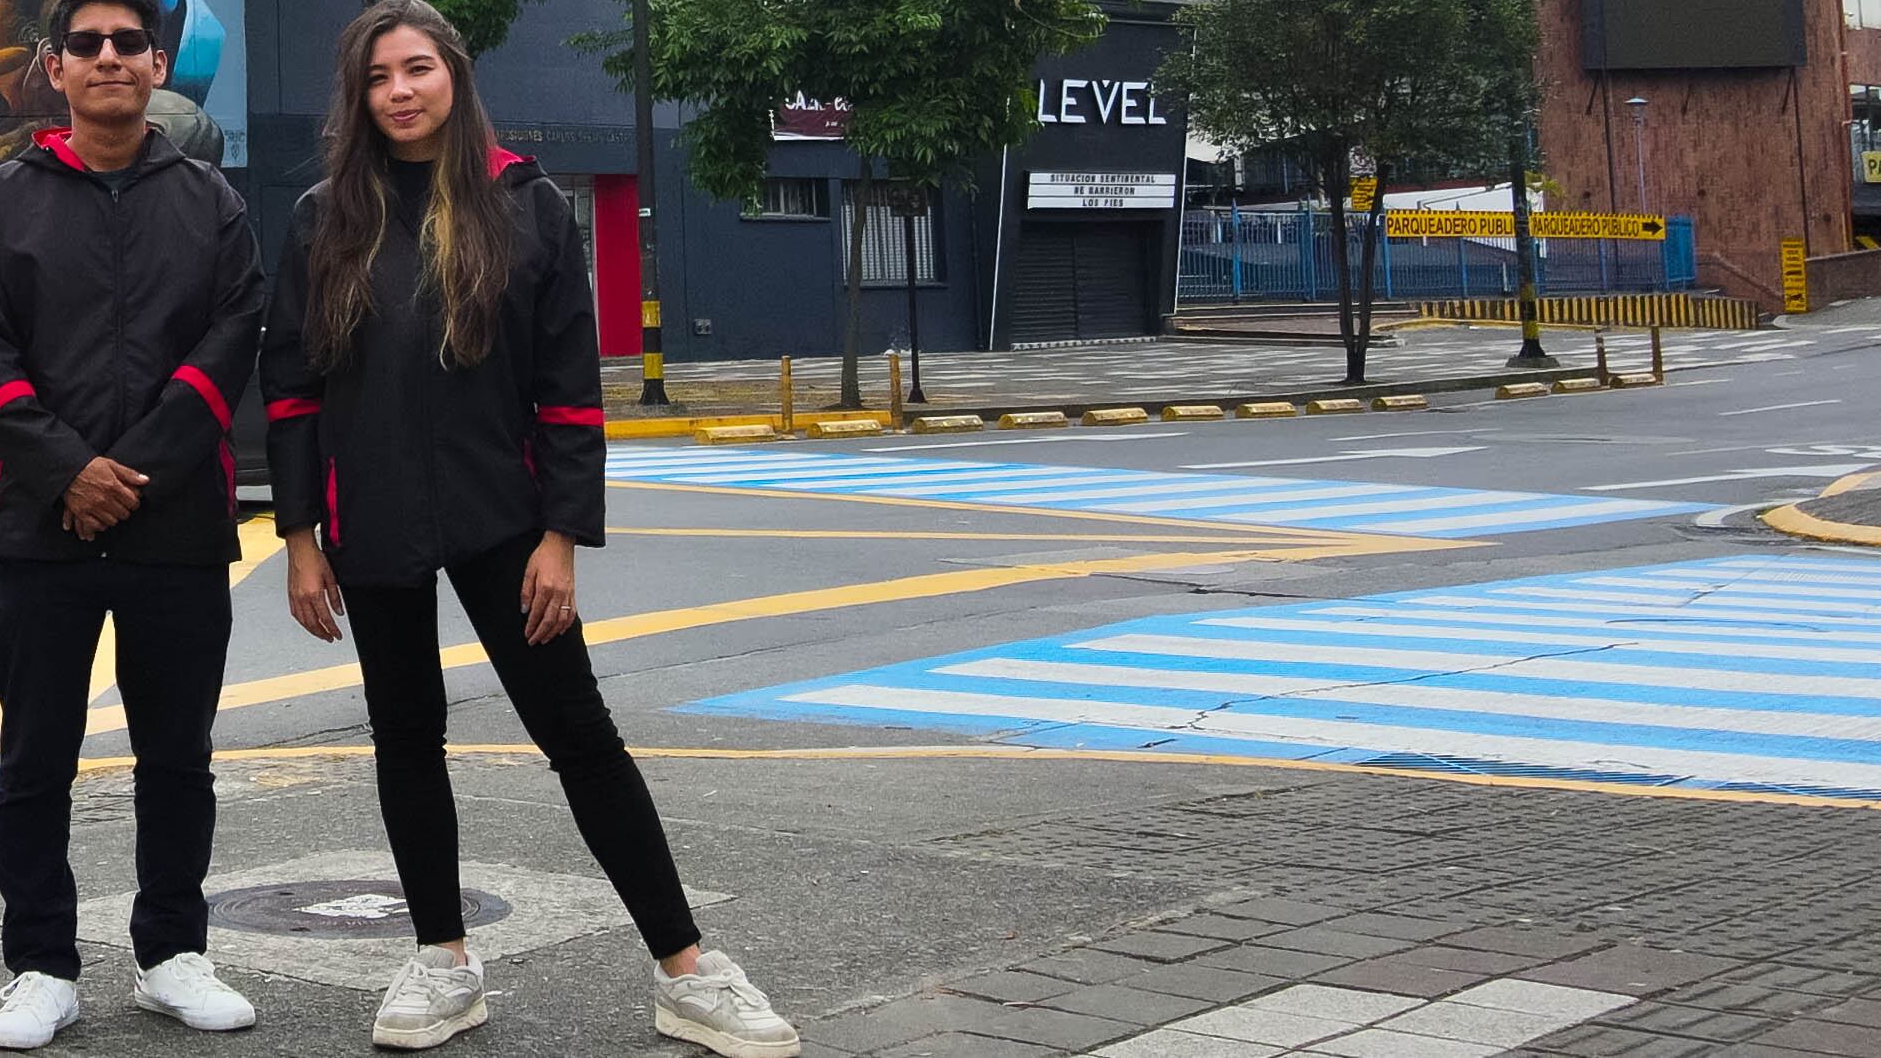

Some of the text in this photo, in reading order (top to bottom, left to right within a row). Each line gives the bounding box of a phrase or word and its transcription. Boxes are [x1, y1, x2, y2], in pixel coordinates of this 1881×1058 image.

[1037, 78, 1167, 125] LEVEL
[1050, 174, 1096, 183] SITUACION
[1082, 198, 1124, 207] LOS PIES
[1386, 217, 1513, 234] PARQUEADERO PUBLI
[1532, 217, 1639, 237] PARQUEADERO PUBLICO
